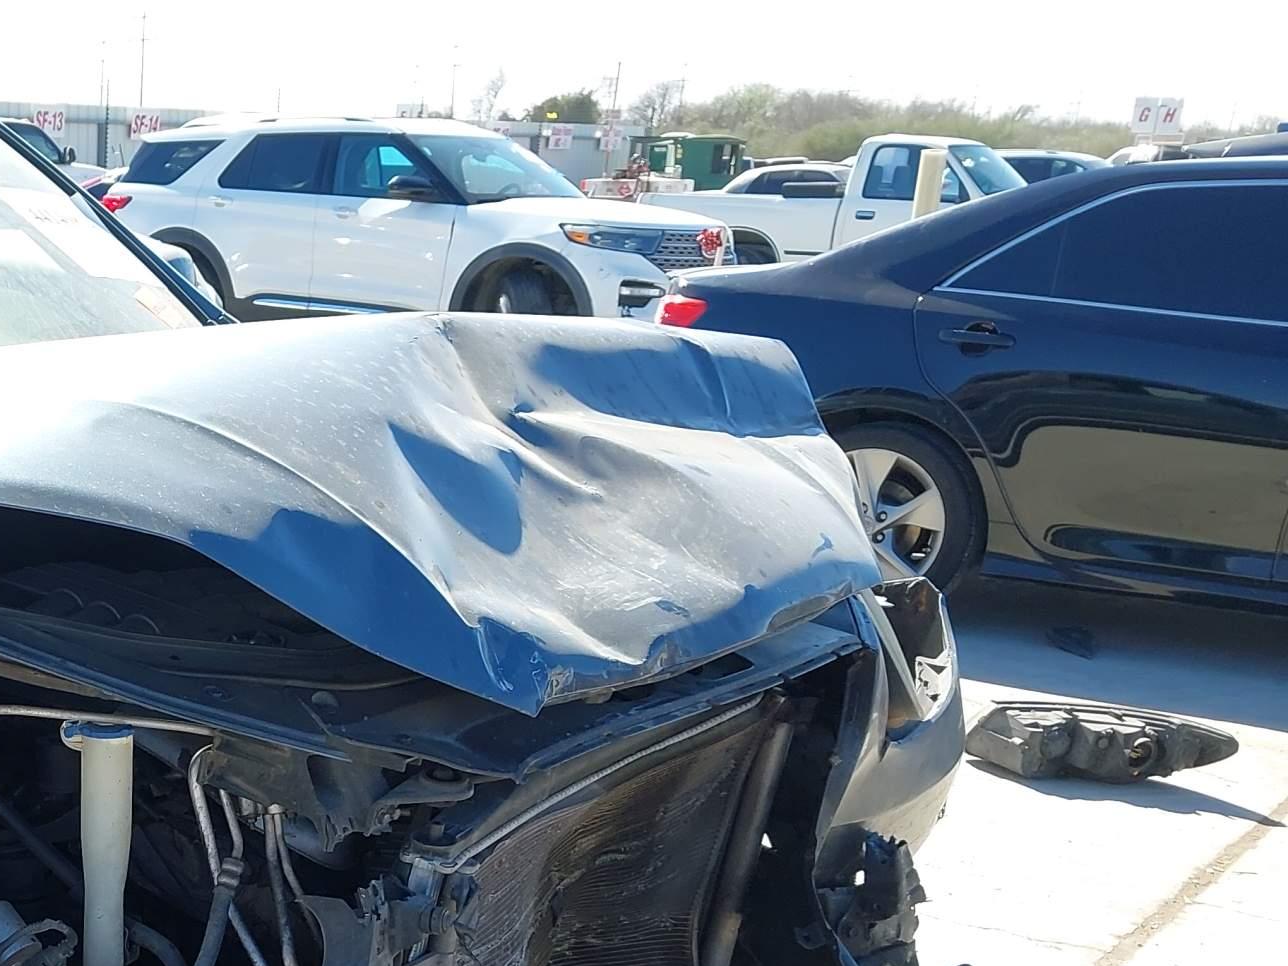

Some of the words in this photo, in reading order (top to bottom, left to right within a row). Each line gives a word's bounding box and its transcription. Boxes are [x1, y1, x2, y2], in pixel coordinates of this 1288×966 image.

[35, 110, 65, 131] SF-13
[1139, 106, 1152, 122] G
[1162, 107, 1178, 123] H
[132, 114, 160, 134] SF-14
